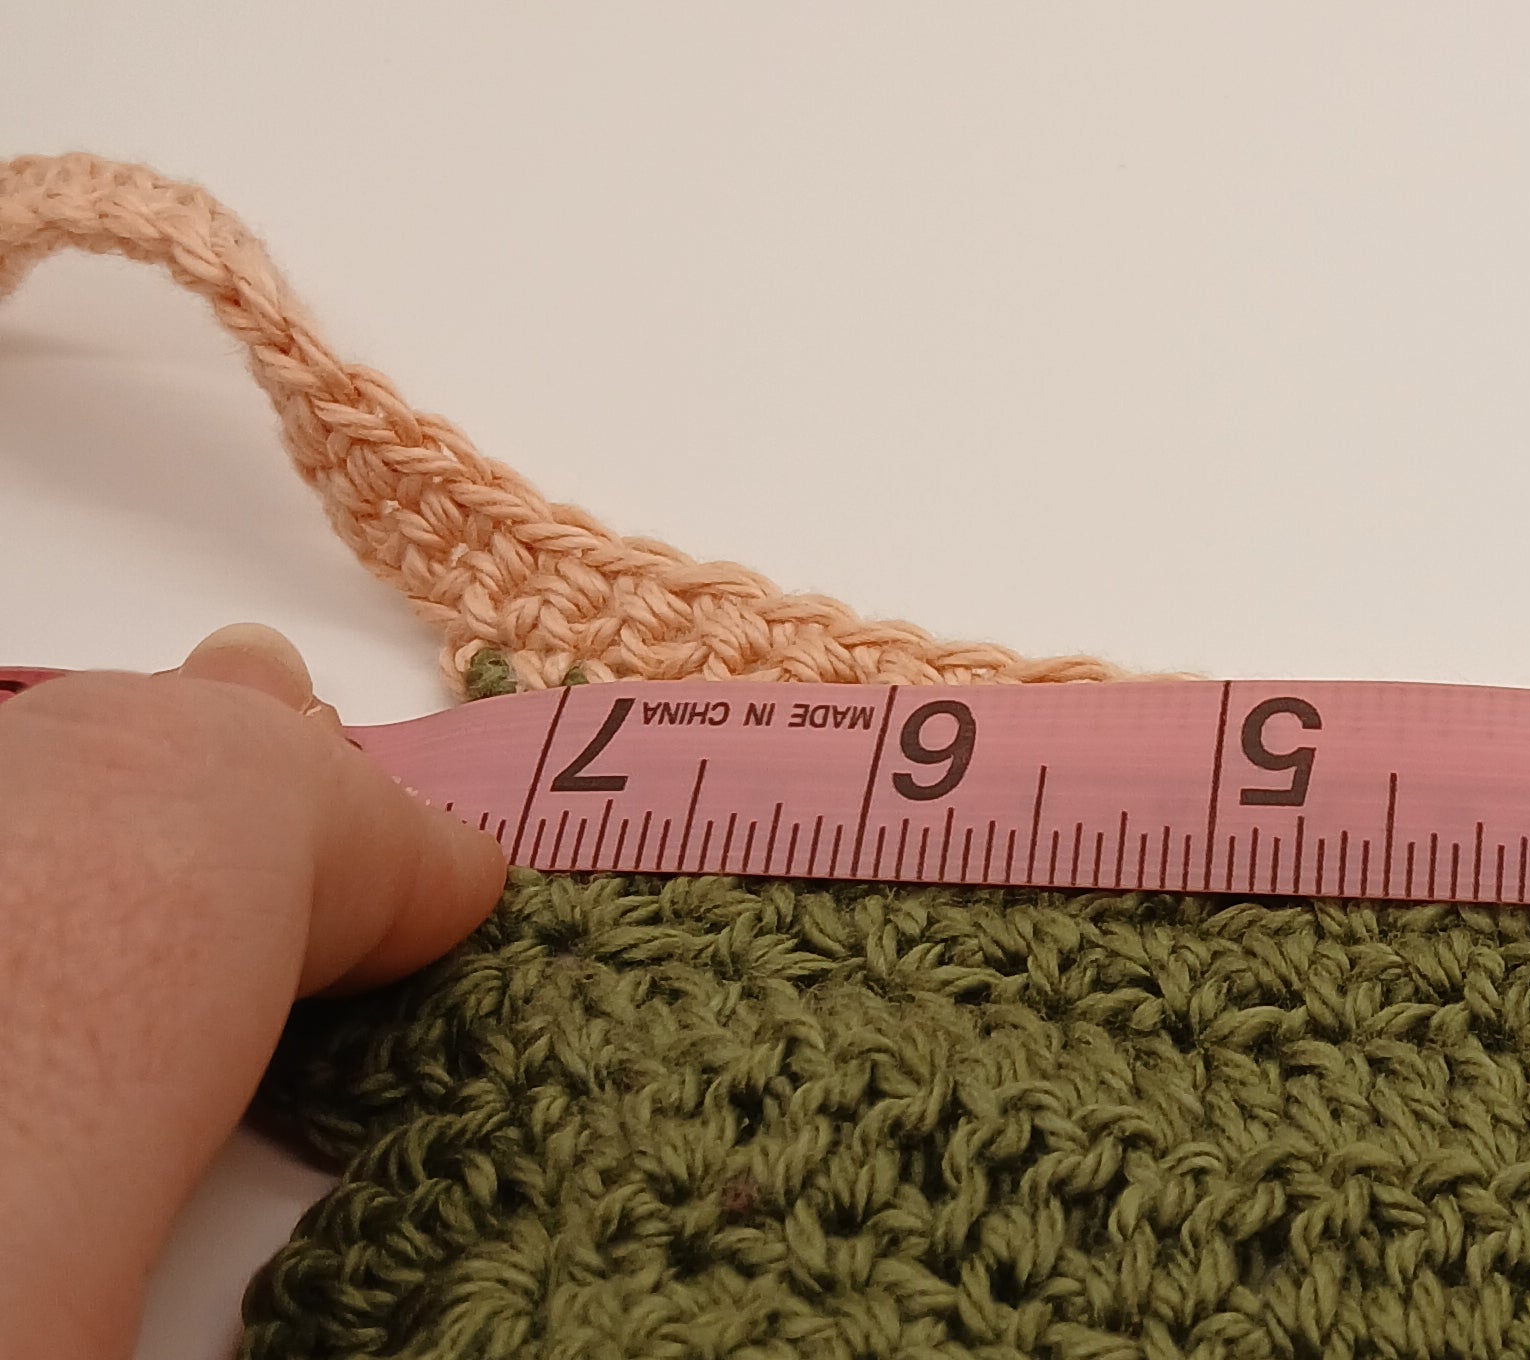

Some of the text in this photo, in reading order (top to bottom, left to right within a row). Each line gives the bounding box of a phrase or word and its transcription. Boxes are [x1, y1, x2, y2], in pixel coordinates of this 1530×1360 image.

[549, 697, 636, 793] 7
[642, 700, 875, 731] MADE IN CHINA
[891, 699, 977, 801] 6
[1239, 696, 1323, 807] 5
